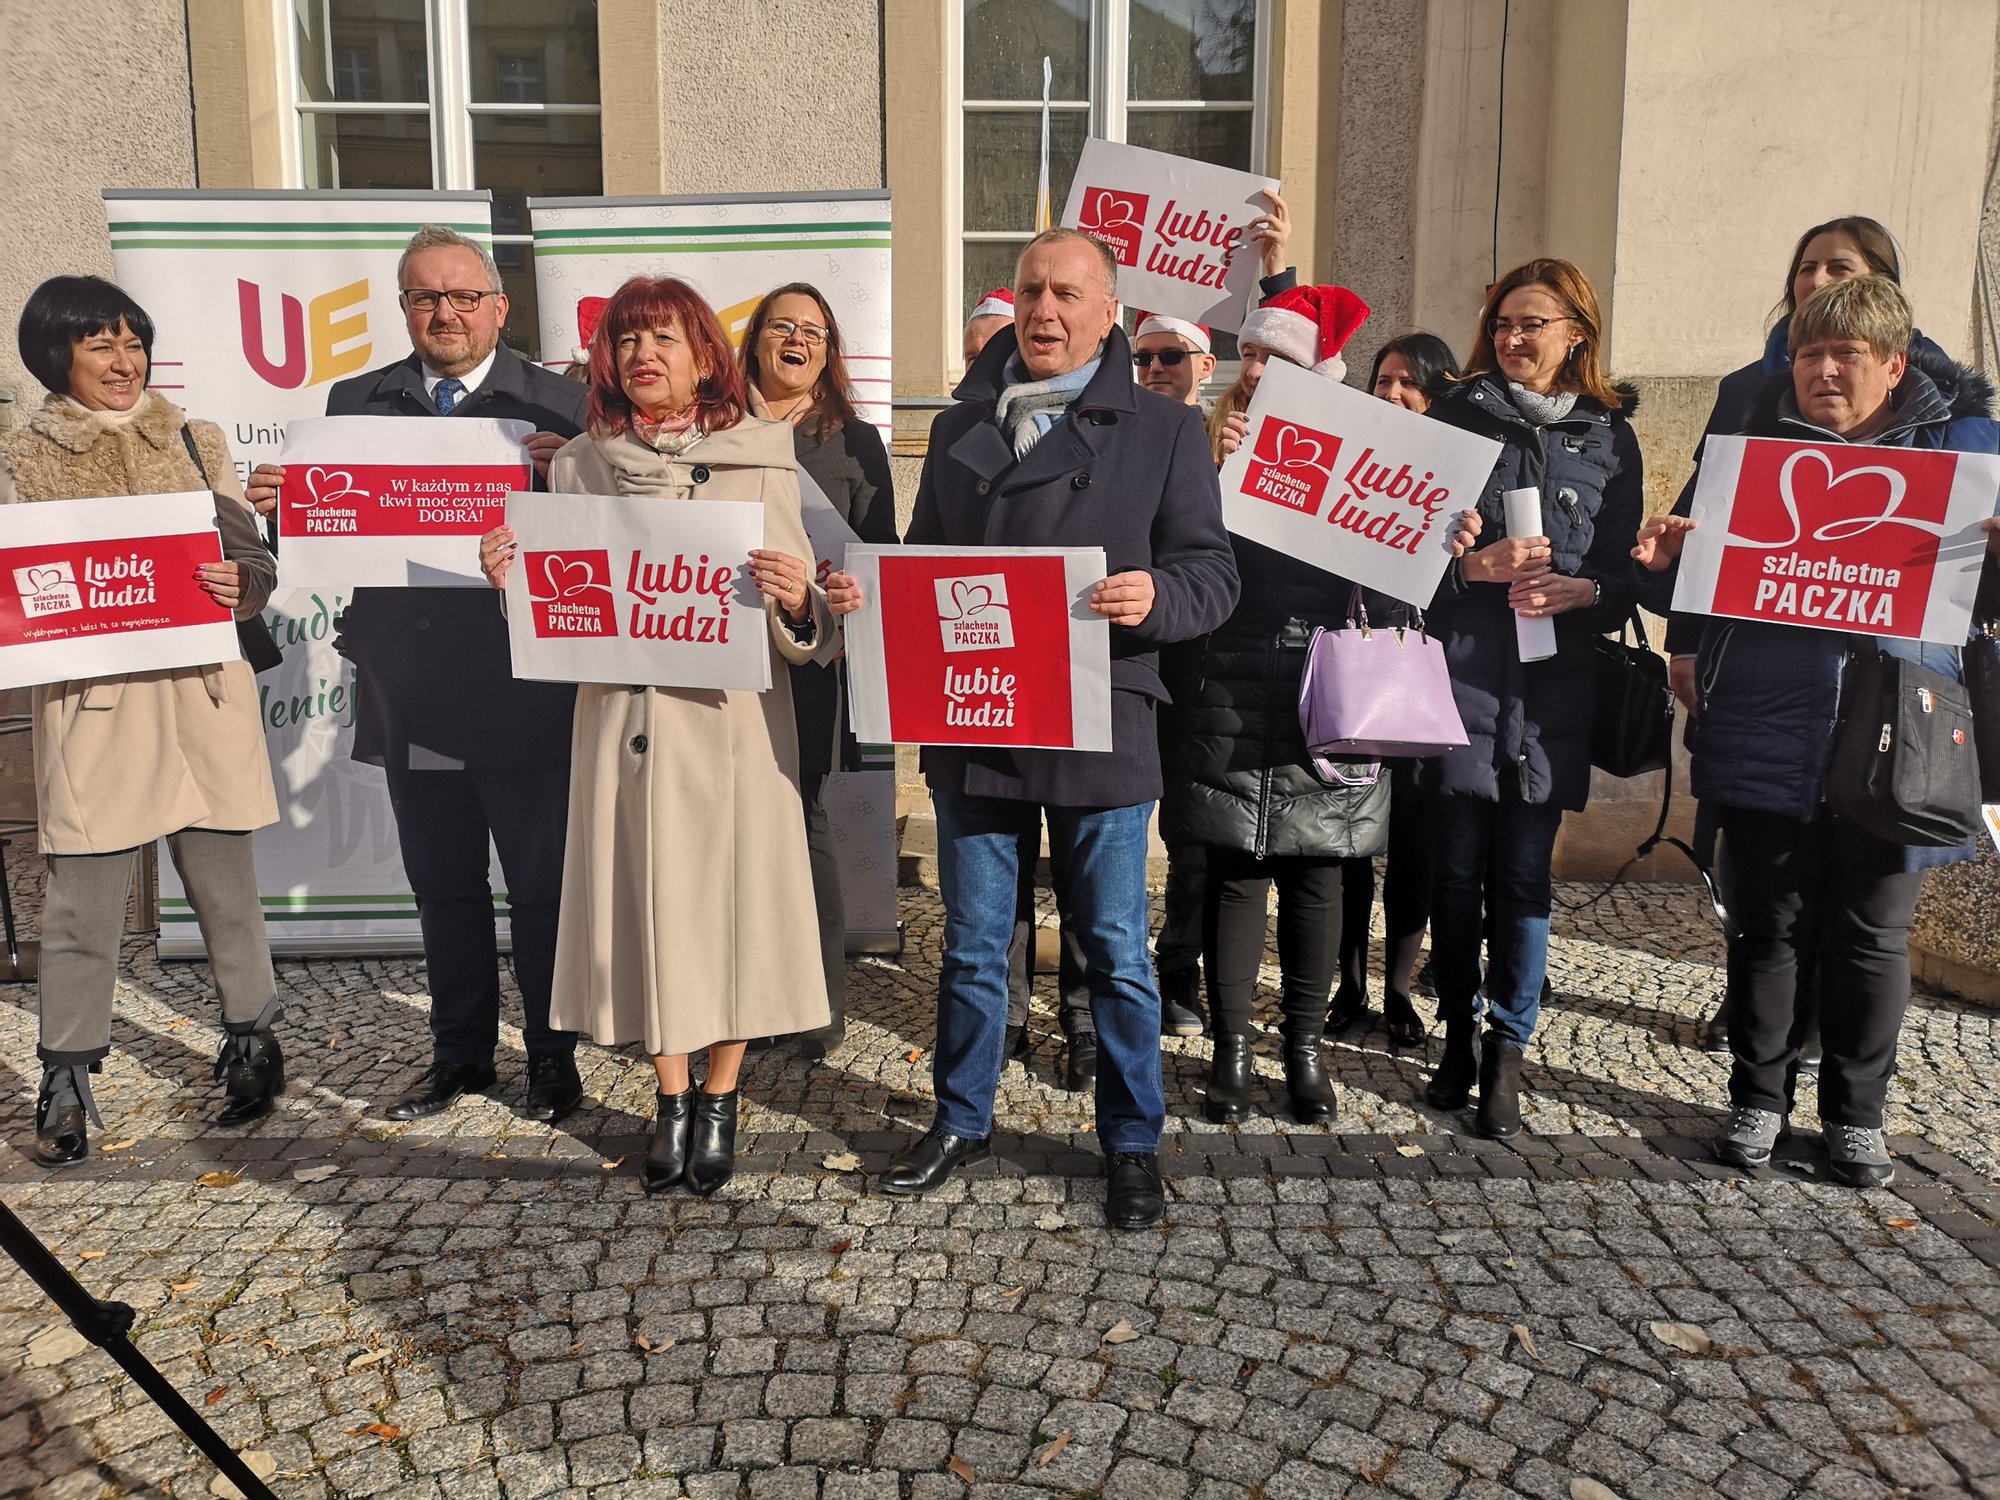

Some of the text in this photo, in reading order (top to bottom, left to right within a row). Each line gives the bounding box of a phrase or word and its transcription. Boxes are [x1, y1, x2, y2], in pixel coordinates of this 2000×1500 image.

[1154, 200, 1243, 259] Lubię
[1146, 243, 1232, 290] ludzi
[237, 278, 373, 389] UE
[391, 479, 512, 495] W każdym z nas
[1255, 476, 1307, 508] PACZKA
[1262, 466, 1312, 493] szlachetna
[1344, 447, 1449, 521] Lubię
[306, 507, 357, 518] szlachetna
[379, 493, 412, 507] tkwi
[416, 497, 449, 507] moc
[306, 519, 357, 532] PACZKA
[419, 510, 483, 523] DOBRA!
[1327, 493, 1431, 555] ludzi
[84, 553, 156, 587] Lubię
[626, 549, 733, 606] Lubię
[1762, 552, 1901, 588] szlachetna
[32, 593, 69, 602] szlachetna
[34, 600, 71, 611] PACZKA
[89, 582, 156, 608] ludzi
[1754, 579, 1894, 627] PACZKA
[548, 602, 600, 616] szlachetna
[80, 623, 98, 632] ludzi
[548, 615, 602, 632] PACZKA
[629, 603, 730, 644] ludzi
[954, 620, 999, 631] szlachetna
[954, 632, 1000, 645] PACZKA
[944, 665, 1017, 703] Lubię
[946, 701, 1015, 727] ludzi
